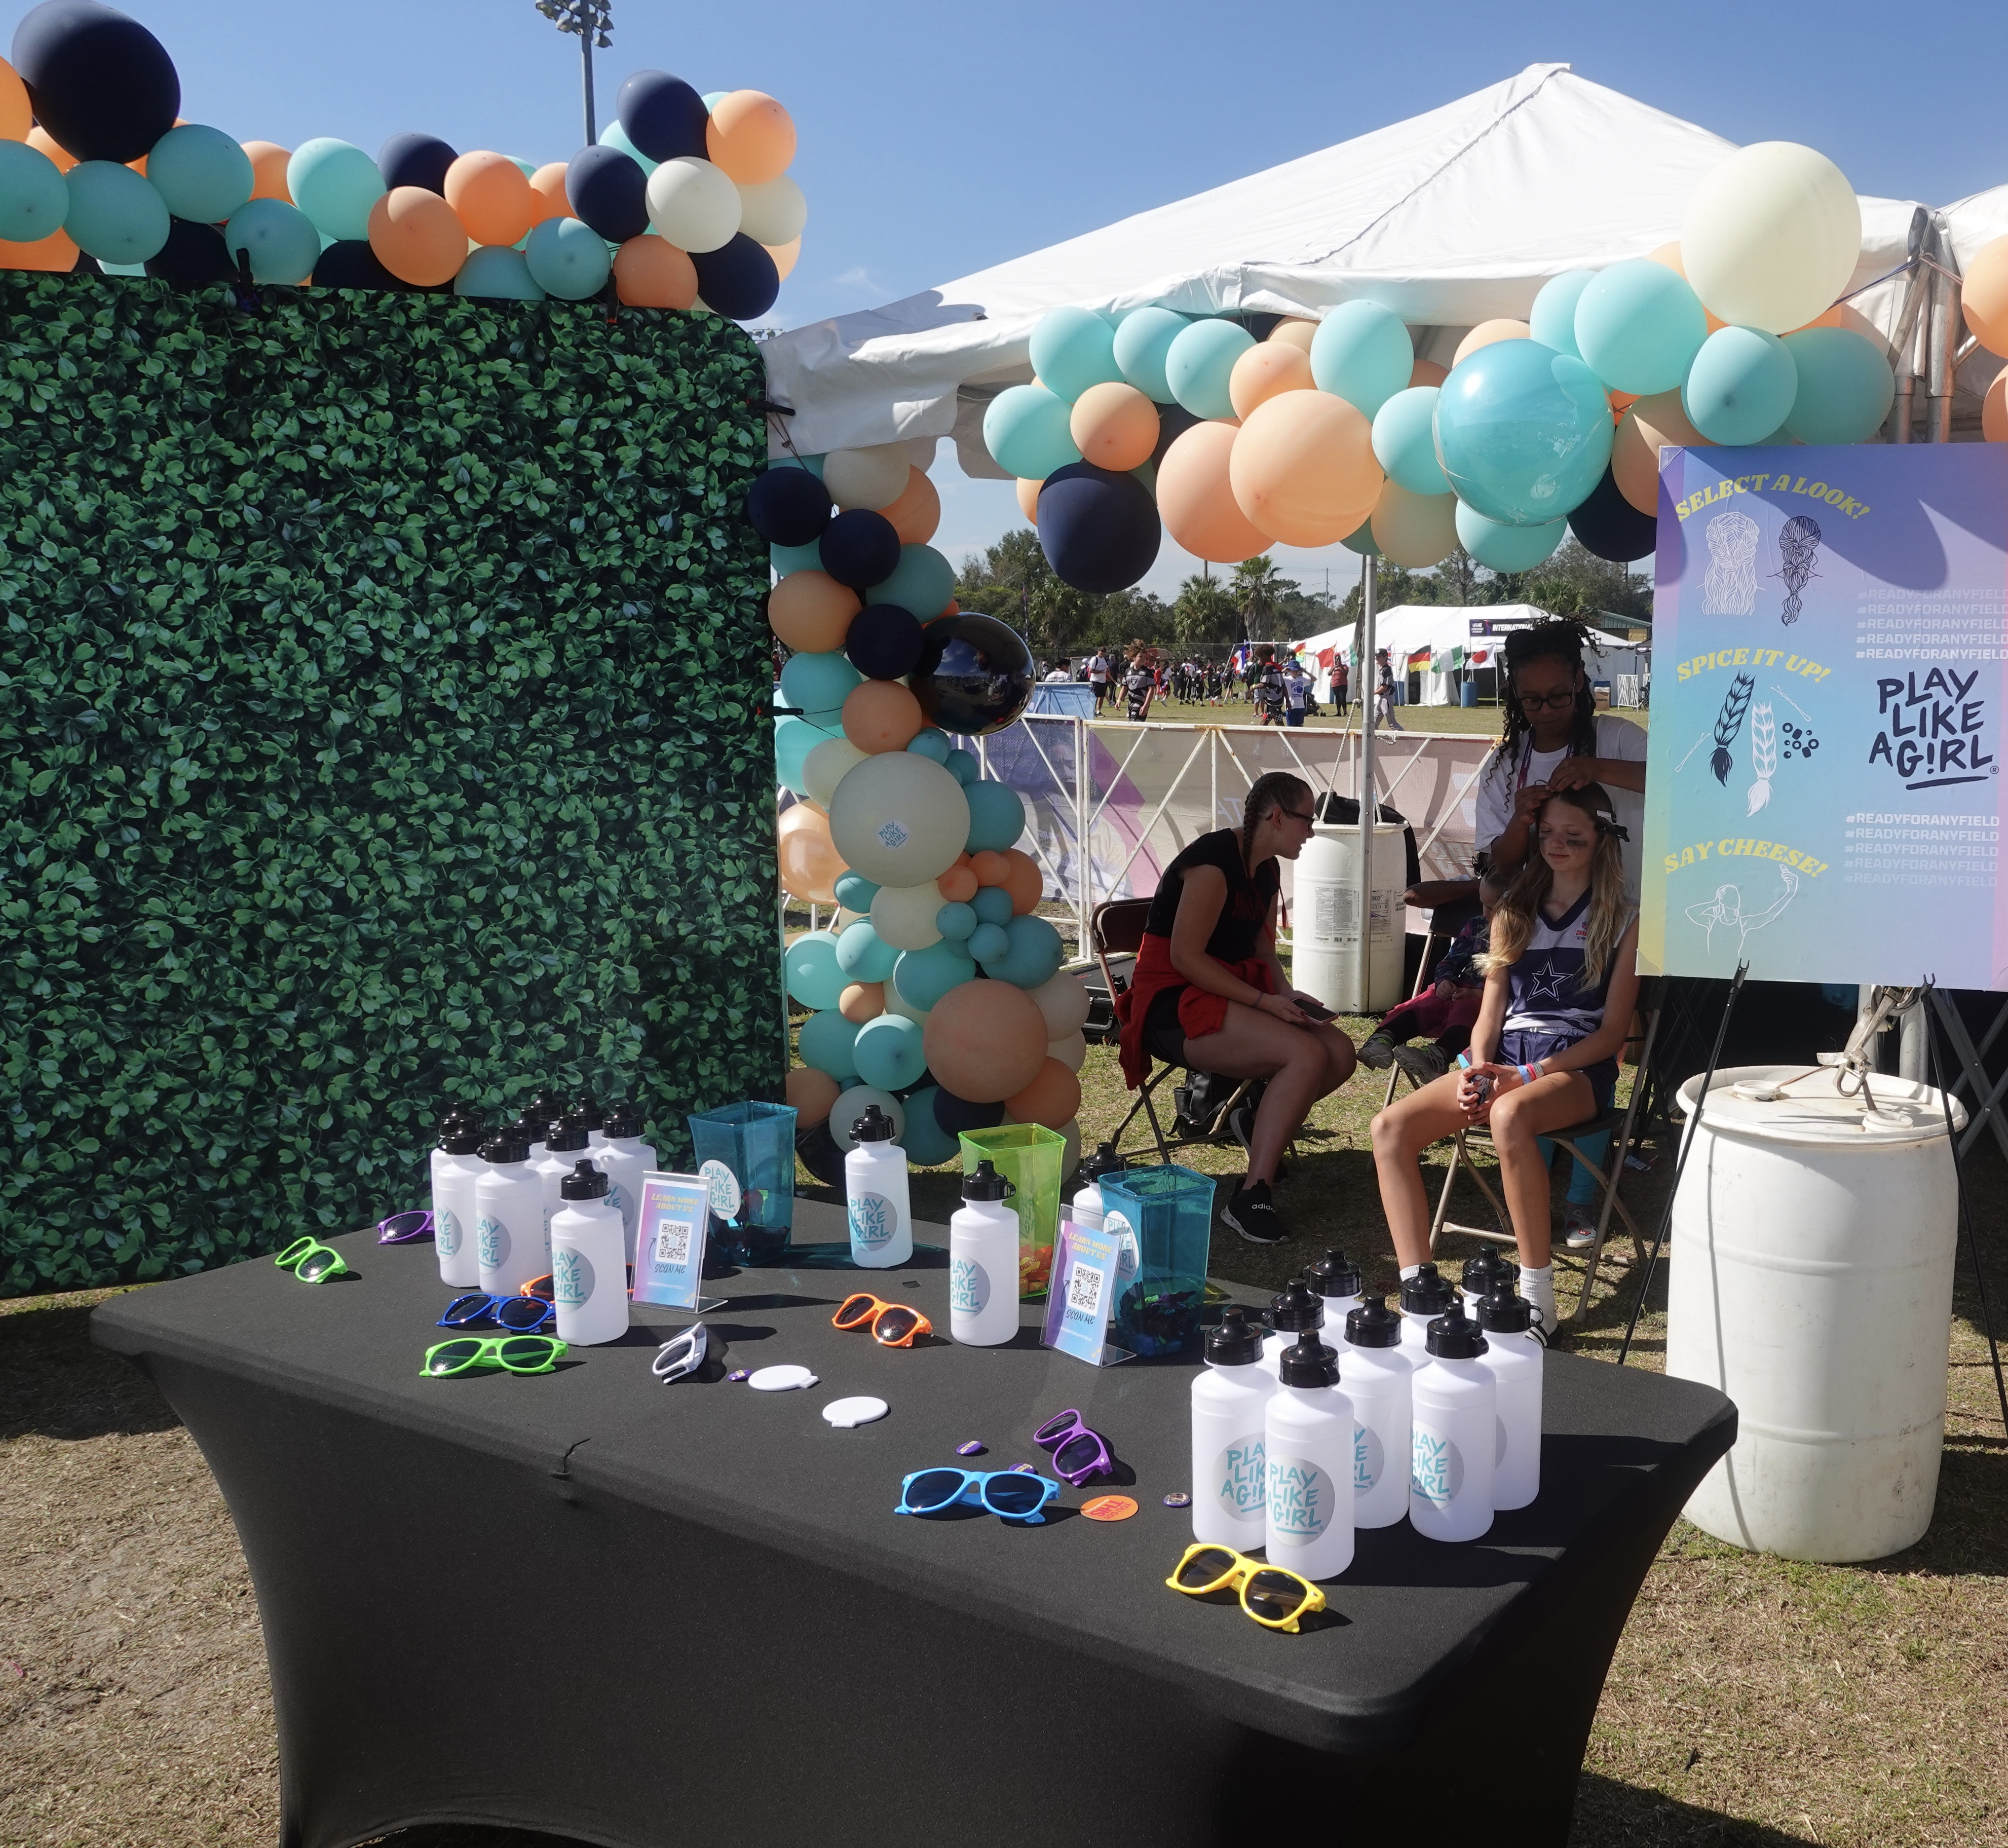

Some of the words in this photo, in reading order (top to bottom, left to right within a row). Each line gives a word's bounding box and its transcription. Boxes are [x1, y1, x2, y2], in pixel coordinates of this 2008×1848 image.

[1675, 473, 1770, 522] SELECT
[1770, 474, 1791, 492] A
[1791, 476, 1871, 520] LOOK!
[1857, 619, 2008, 629] #READYFORANYFIELD
[1856, 634, 2008, 645] #READYFORANYFIELD
[1855, 649, 2008, 660] #READYFORANYFIELD
[1677, 648, 1750, 683] SPICE
[1751, 648, 1785, 666] IT
[1785, 654, 1831, 683] UP!
[1877, 667, 1979, 714] PLAY
[1892, 700, 1985, 739] LIKE
[1845, 813, 2000, 827] #READYFORANYFIELD
[879, 821, 895, 839] PLAY
[884, 825, 901, 841] LIKE
[1845, 828, 1999, 842] #READYFORANYFIELD
[1844, 843, 1999, 857] #READYFORANYFIELD
[1664, 841, 1714, 875] SAY
[1718, 839, 1828, 878] CHEESE!
[1844, 858, 1999, 873] #READYFORANYFIELD
[704, 1166, 730, 1183] PLAY
[651, 1193, 676, 1202] LEARN
[677, 1196, 700, 1205] MORE
[655, 1202, 682, 1212] ABOUT
[850, 1198, 884, 1213] PLAY
[437, 1208, 449, 1223] AY
[1252, 1203, 1276, 1213] adida
[854, 1210, 886, 1226] LIKE
[439, 1223, 451, 1236] KE
[477, 1217, 500, 1236] LAY
[440, 1236, 454, 1251] RL
[479, 1232, 500, 1249] IKE
[1069, 1232, 1091, 1246] LEARN
[1091, 1239, 1113, 1254] MORE
[478, 1247, 500, 1263] !RL
[1071, 1242, 1096, 1257] ABOUT
[1096, 1251, 1107, 1261] US
[675, 1265, 687, 1274] ME
[1084, 1314, 1095, 1325] ME
[1227, 1443, 1266, 1470] PLA
[1234, 1461, 1266, 1484] LIK
[1269, 1462, 1318, 1491] PLAY
[1273, 1479, 1319, 1507] LIKE
[1089, 1500, 1125, 1517] THIS
[1103, 1511, 1118, 1519] GOT
[1116, 1502, 1133, 1513] YOU
